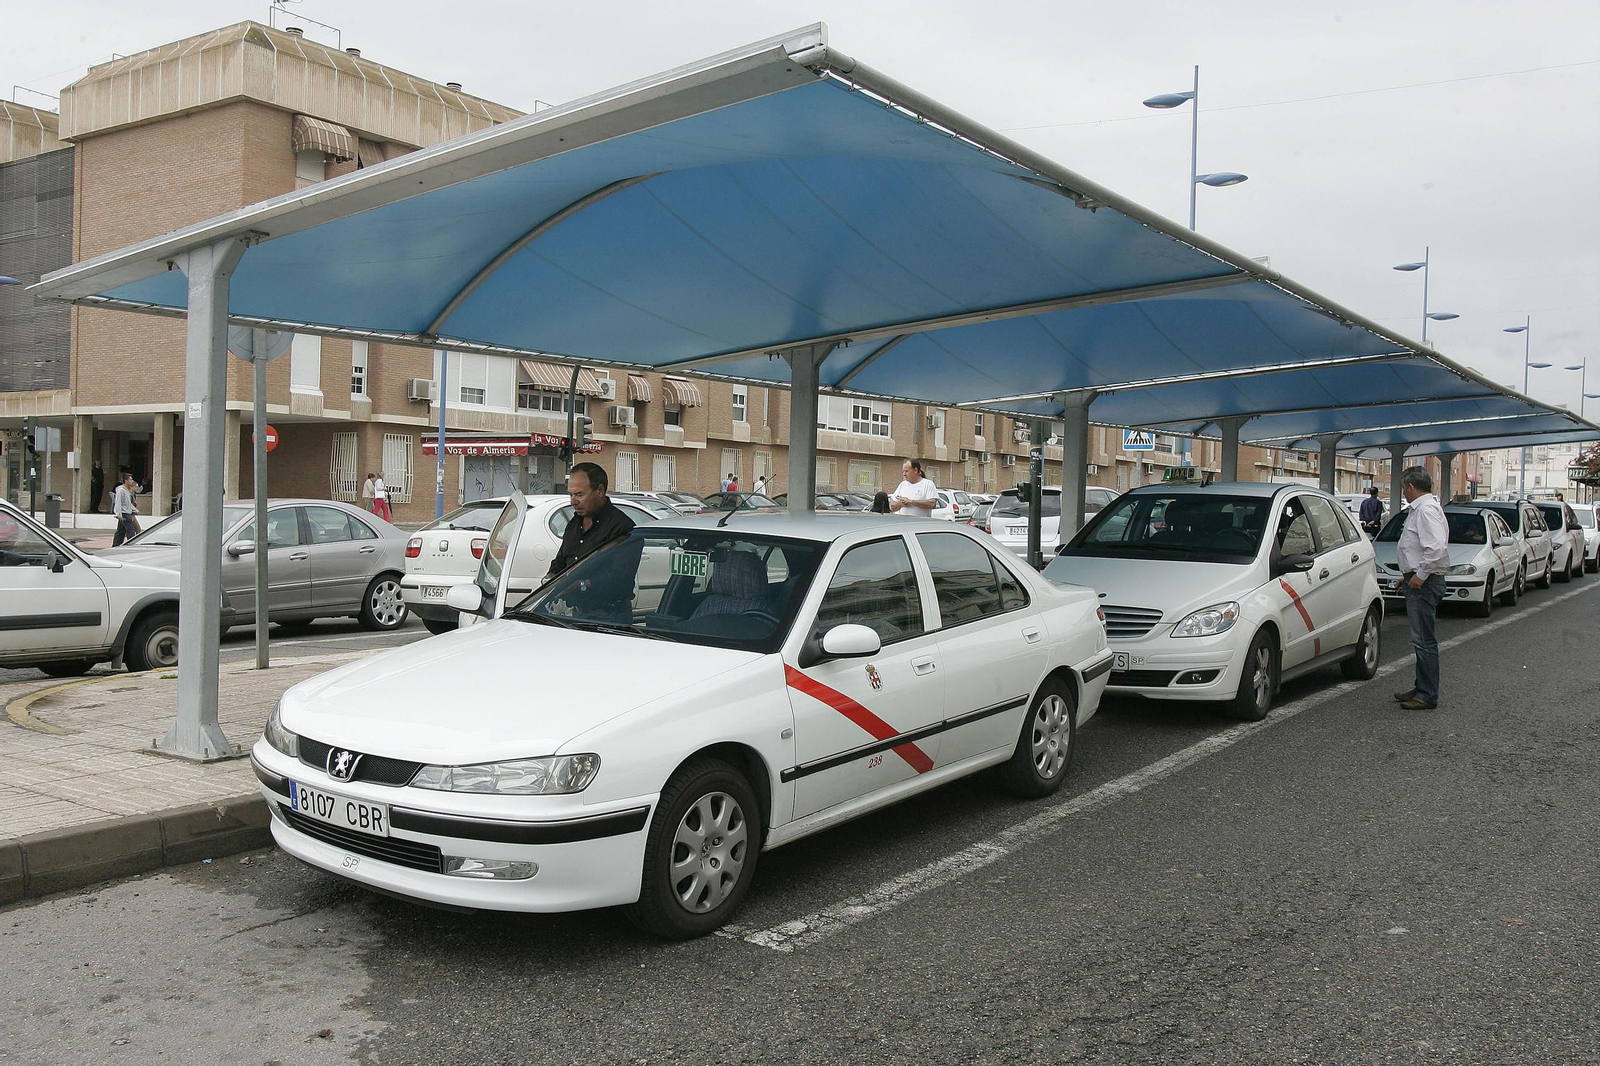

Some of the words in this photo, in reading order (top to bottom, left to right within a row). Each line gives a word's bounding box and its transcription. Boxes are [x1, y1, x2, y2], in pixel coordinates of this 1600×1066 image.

[467, 446, 478, 454] de
[671, 553, 707, 576] LIBRE
[427, 587, 444, 598] 4566
[868, 755, 883, 769] 238
[300, 788, 335, 819] 8107
[346, 801, 383, 833] CBR
[342, 856, 359, 868] SP
